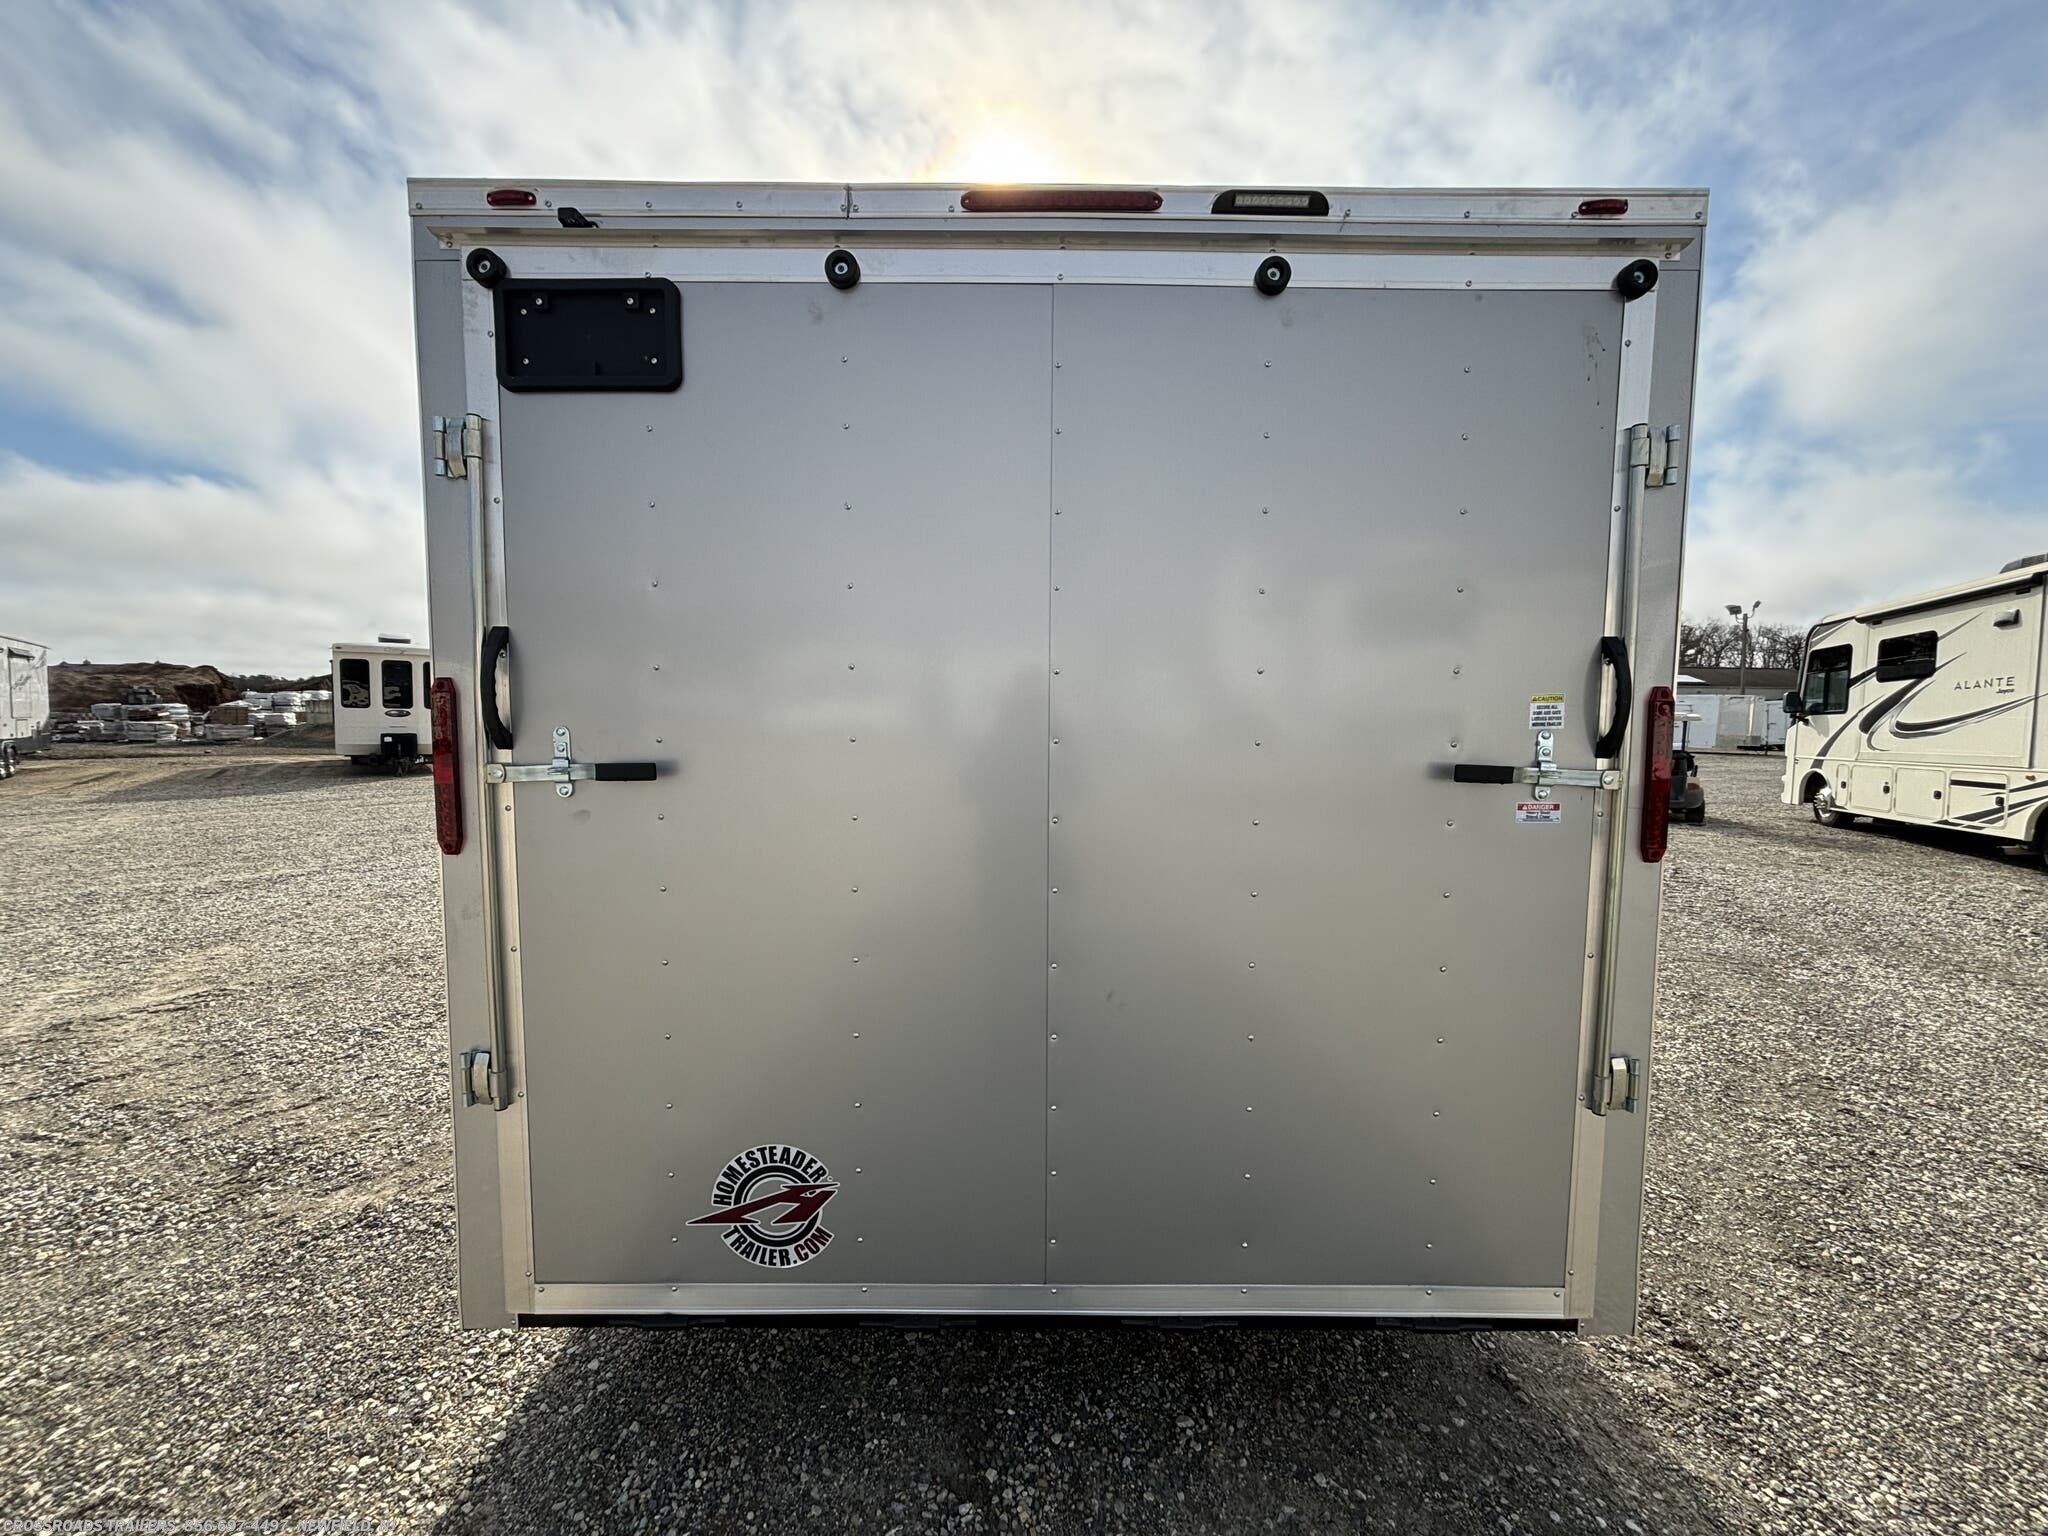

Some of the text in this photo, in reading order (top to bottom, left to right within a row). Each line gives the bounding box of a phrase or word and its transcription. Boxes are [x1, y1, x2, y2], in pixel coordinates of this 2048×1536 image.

[1954, 676, 2015, 691] ALANTE
[712, 1145, 828, 1207] HOMESTEADER
[722, 1224, 833, 1267] TRAILER.COM
